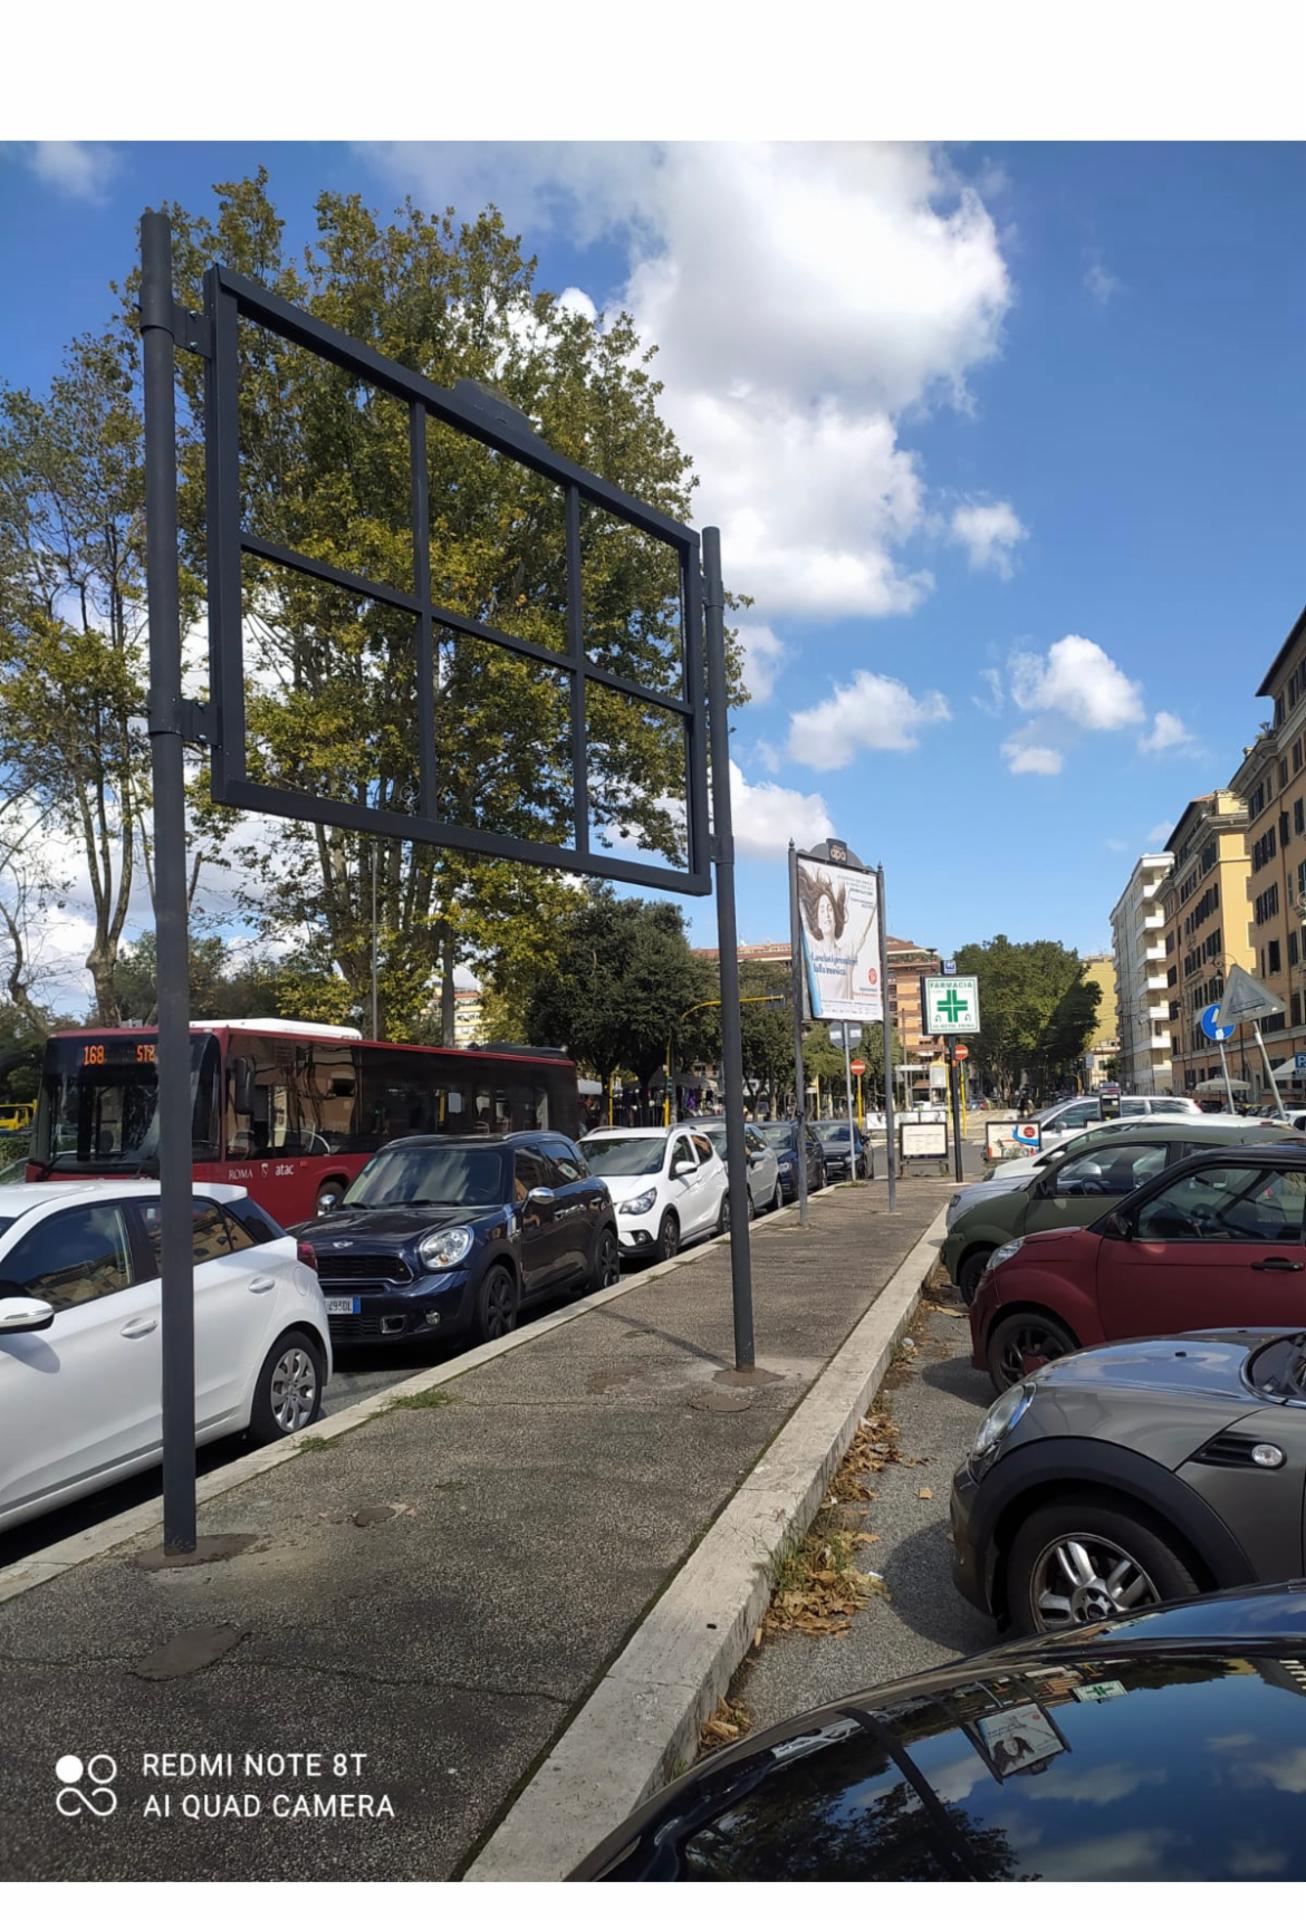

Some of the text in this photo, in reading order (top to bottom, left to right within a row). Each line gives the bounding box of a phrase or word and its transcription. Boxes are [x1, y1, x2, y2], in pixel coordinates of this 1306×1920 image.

[83, 1045, 105, 1066] 168
[228, 1168, 254, 1180] ROMA
[275, 1164, 294, 1176] atac
